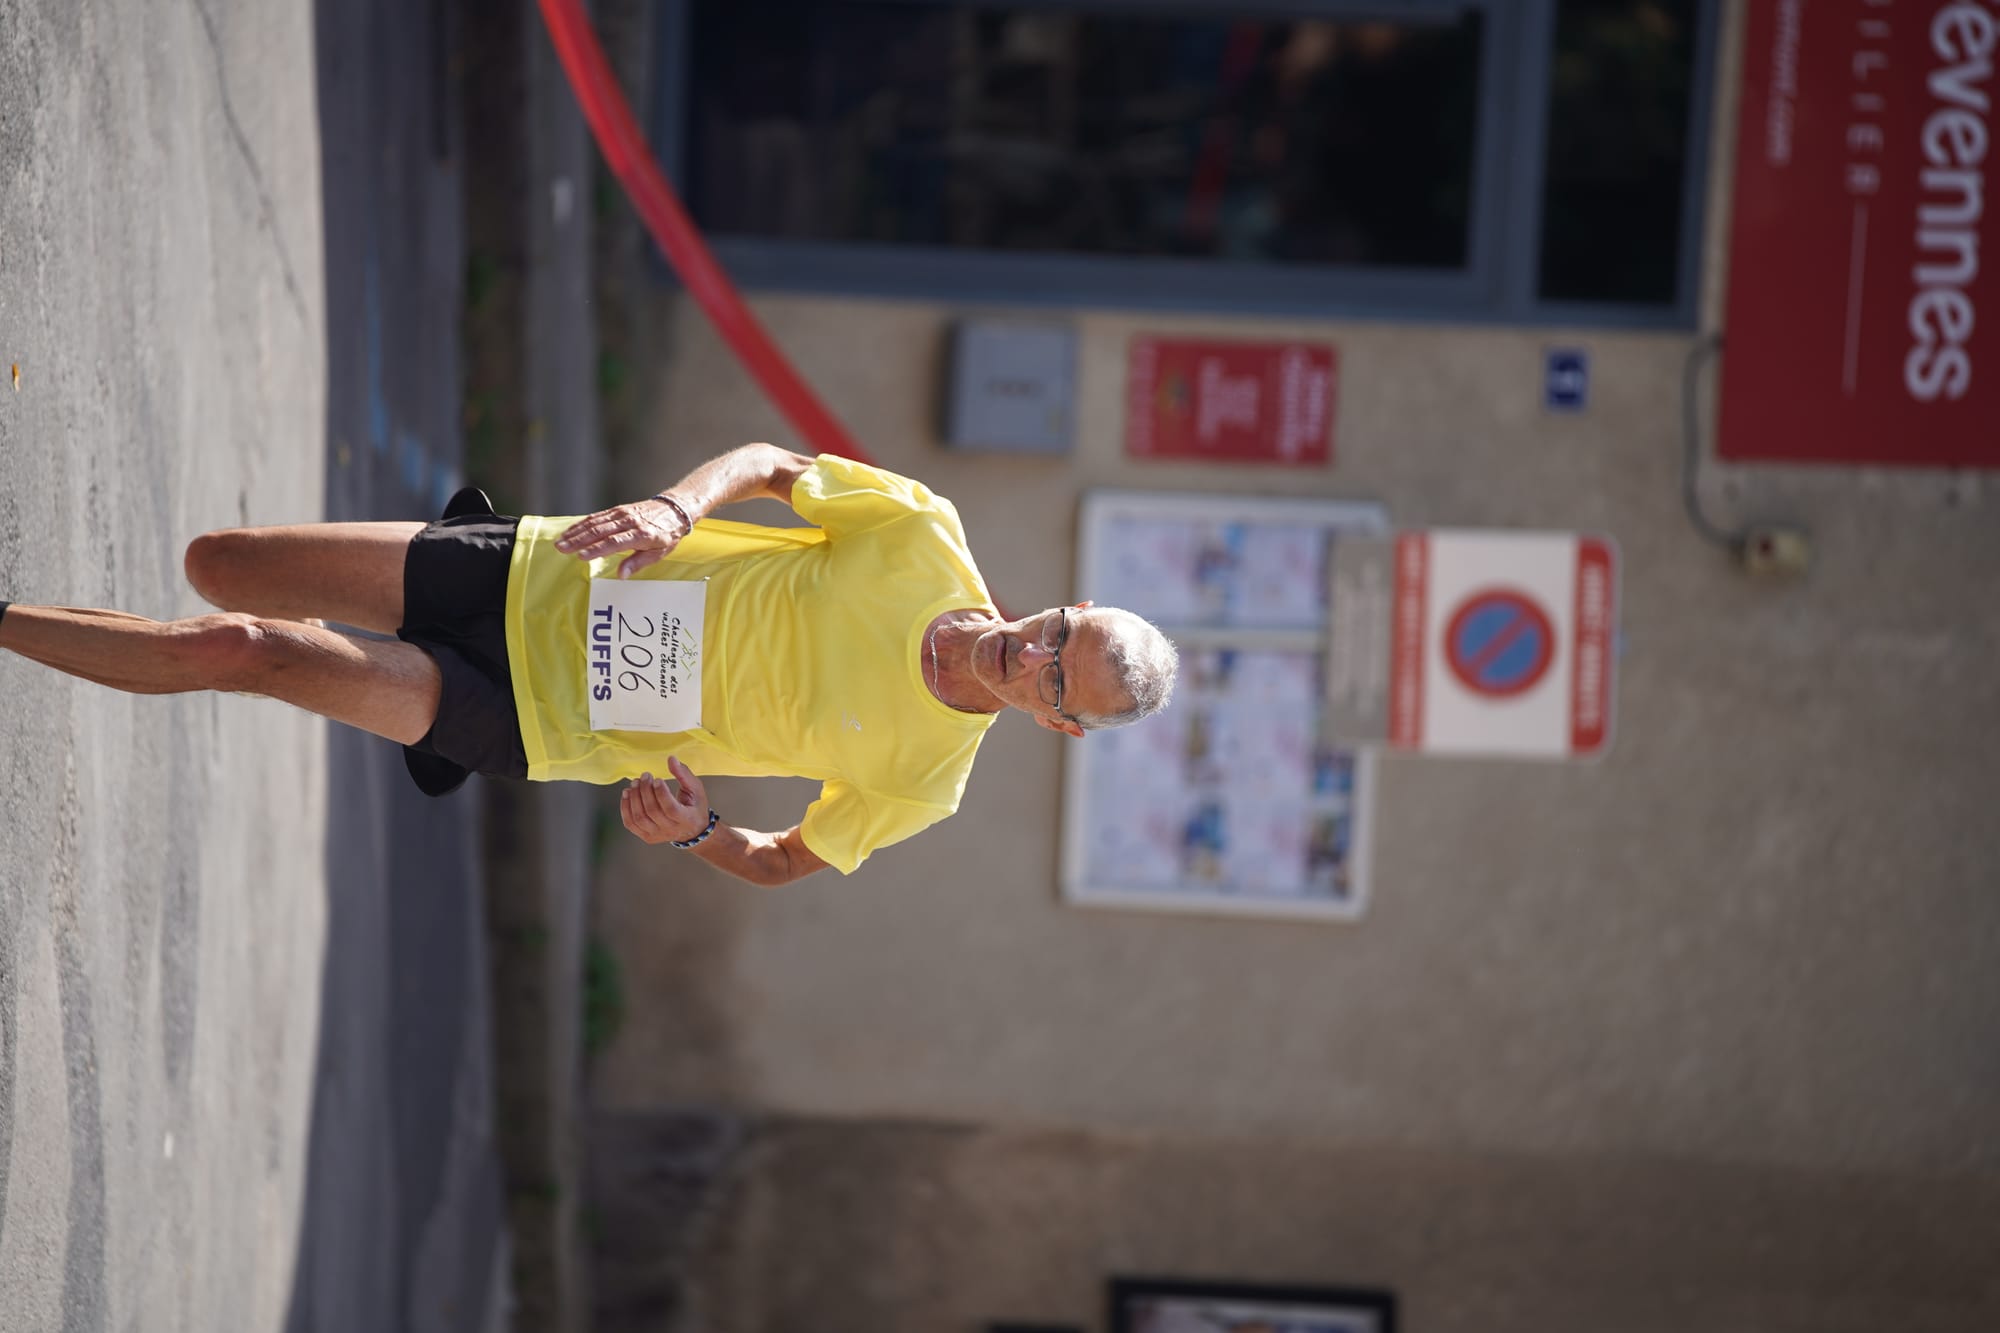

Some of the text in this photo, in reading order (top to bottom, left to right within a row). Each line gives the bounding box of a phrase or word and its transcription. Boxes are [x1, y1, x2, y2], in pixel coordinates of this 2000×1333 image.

[1845, 0, 1893, 194] ILIER
[592, 605, 613, 701] TUFF'S
[618, 611, 656, 691] 206
[659, 611, 671, 699] vallées cévenoles
[667, 617, 681, 694] Challenge des
